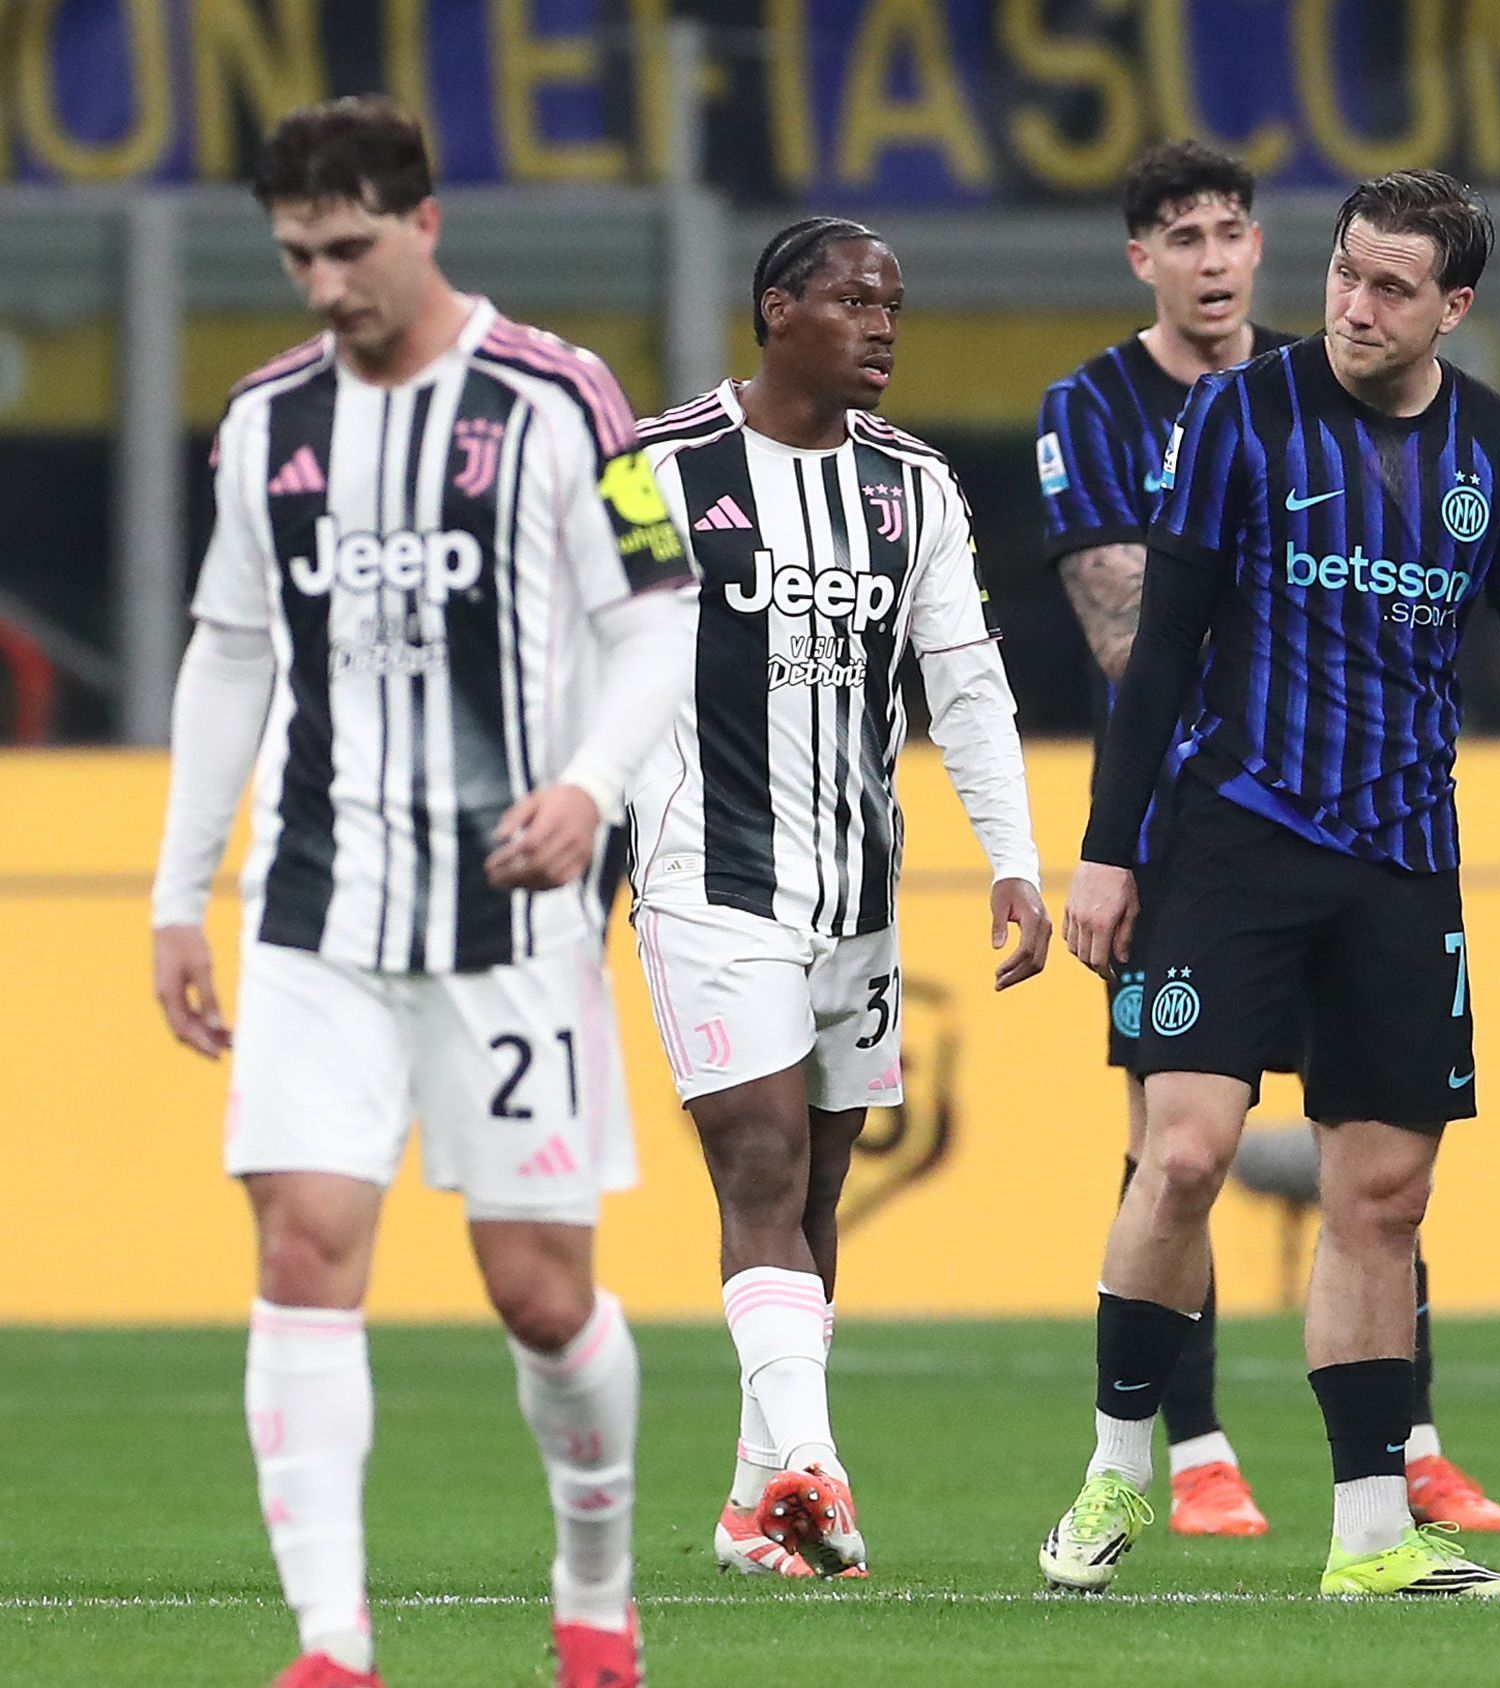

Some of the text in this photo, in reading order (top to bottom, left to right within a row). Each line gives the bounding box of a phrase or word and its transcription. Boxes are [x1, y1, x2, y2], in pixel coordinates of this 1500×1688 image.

[289, 515, 482, 604] Jeep
[724, 550, 895, 633] Jeep
[1286, 541, 1471, 603] betsson
[767, 653, 866, 691] Detroit
[790, 635, 845, 658] VISIT
[1444, 932, 1464, 1018] 7
[489, 1030, 578, 1119] 21
